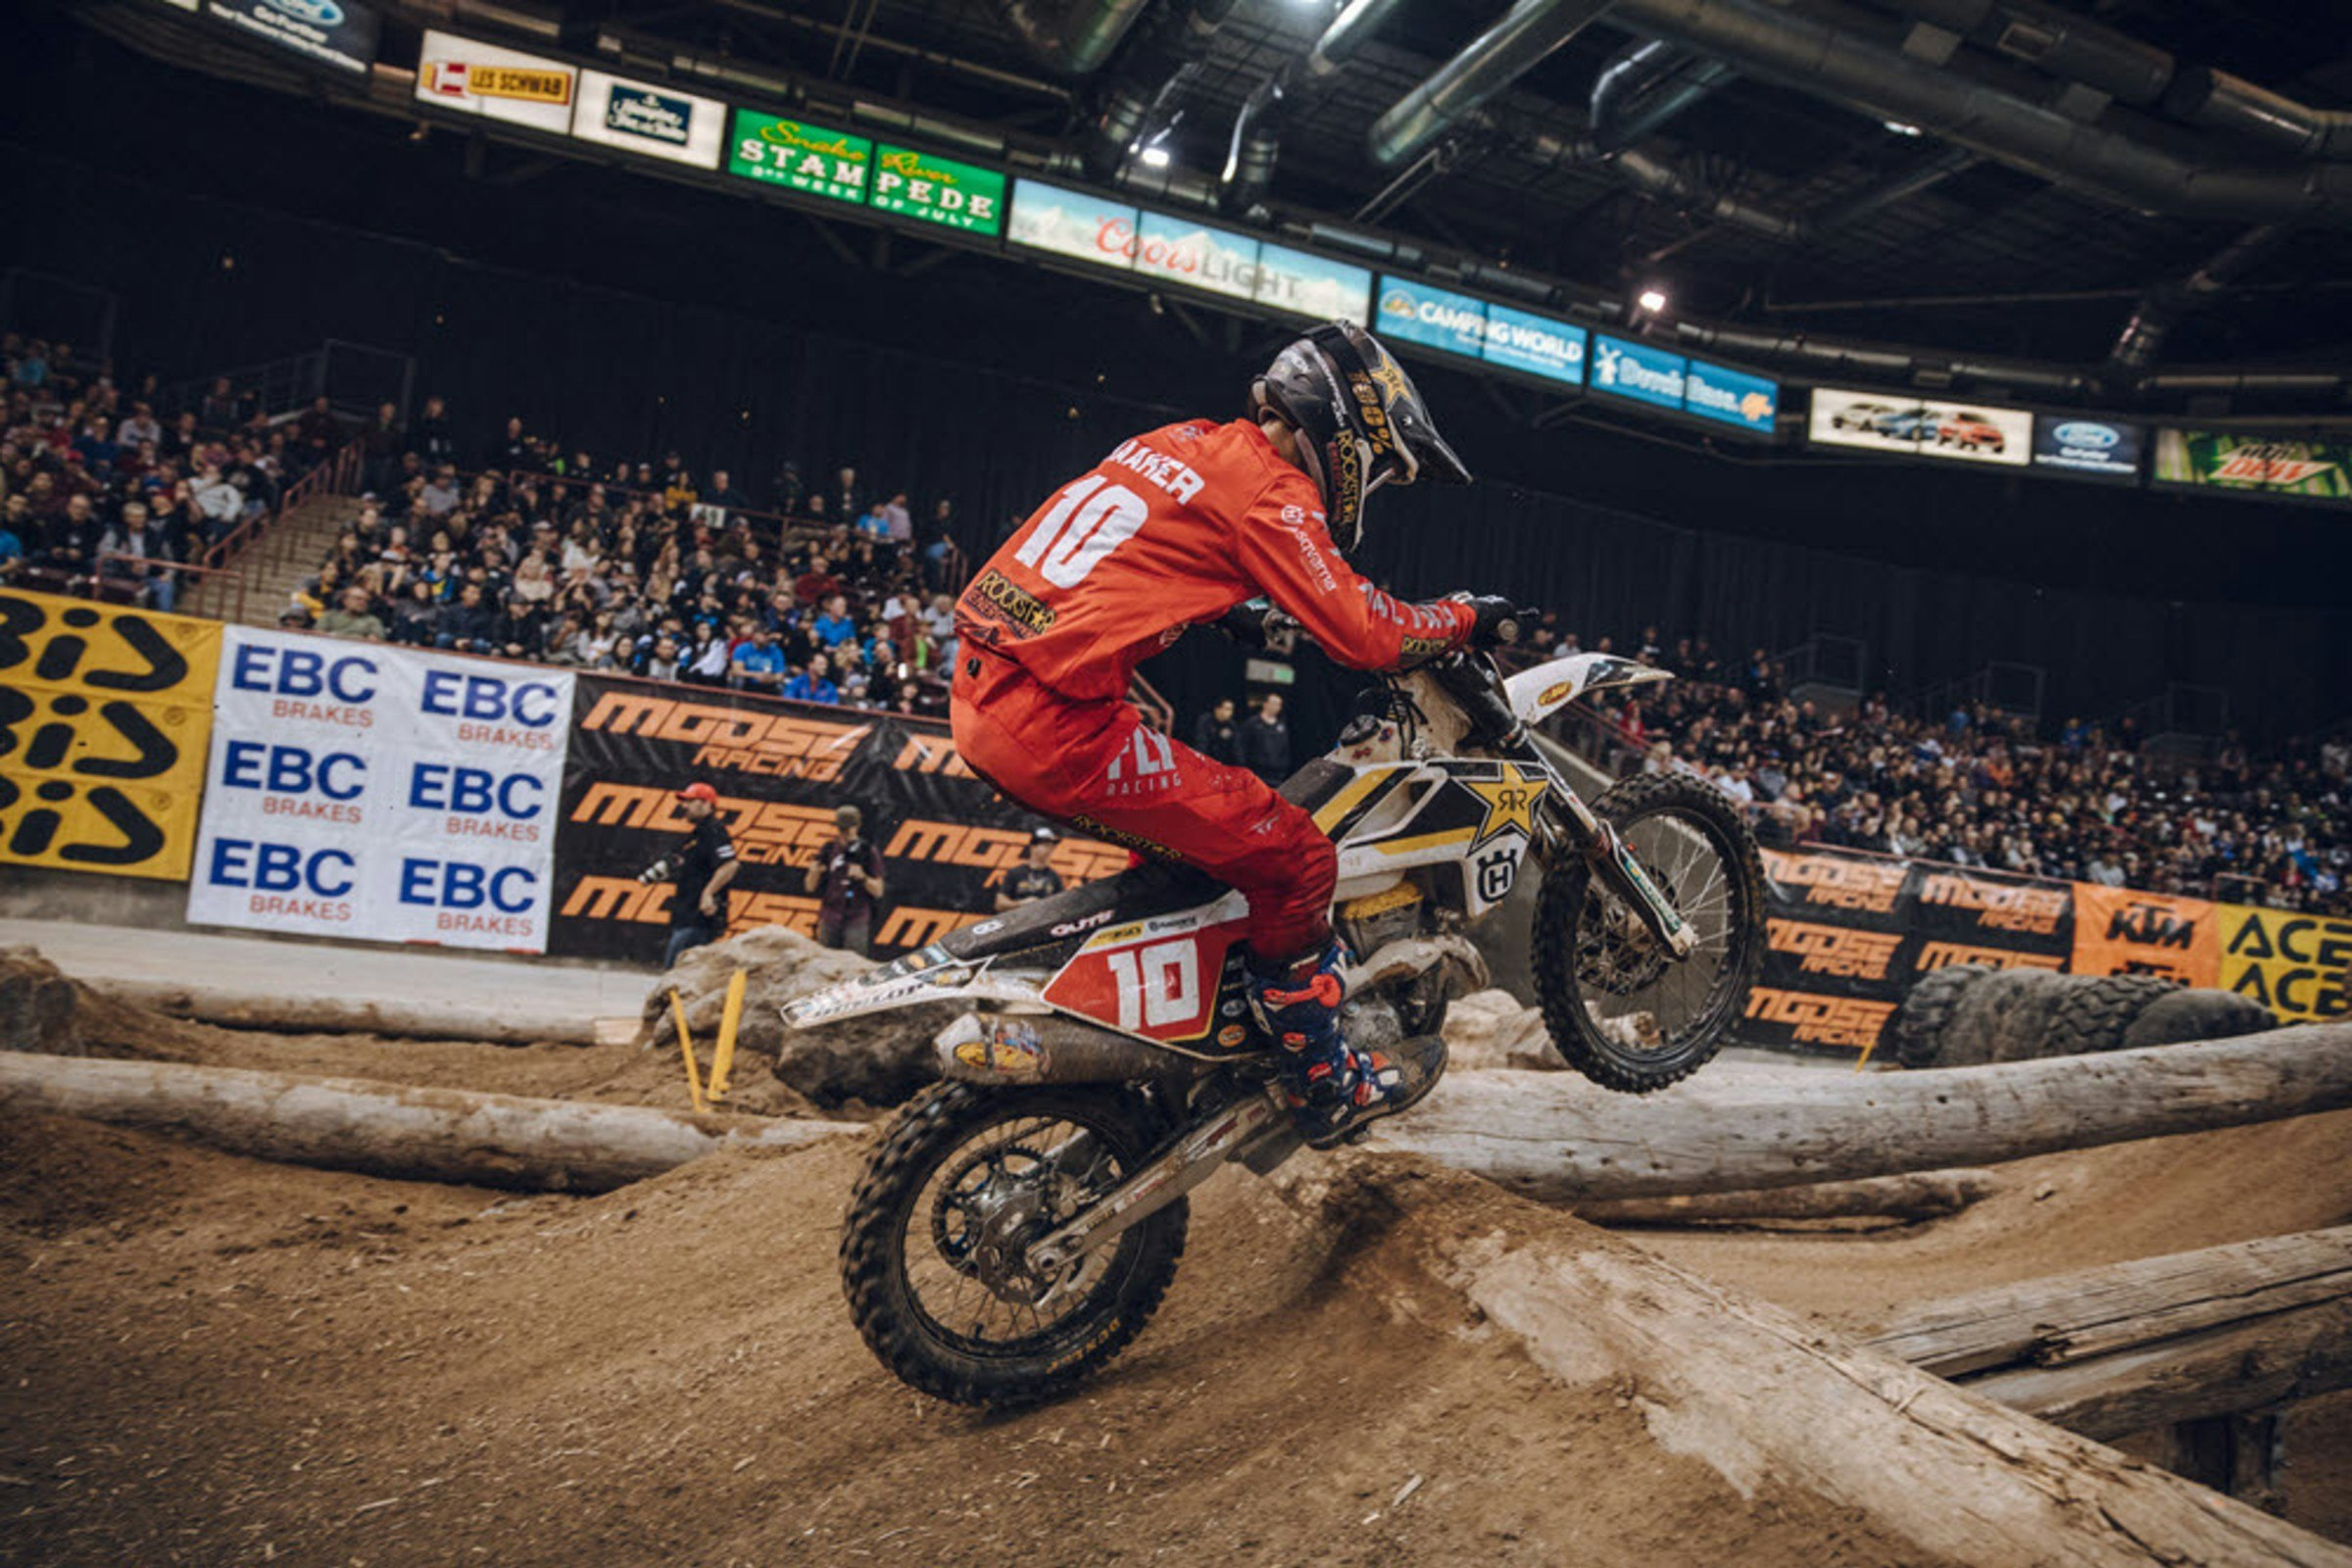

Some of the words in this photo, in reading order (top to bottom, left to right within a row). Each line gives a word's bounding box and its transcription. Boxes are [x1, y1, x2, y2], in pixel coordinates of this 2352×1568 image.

[471, 69, 494, 88] LES
[500, 71, 563, 96] SCHWAB
[740, 138, 994, 220] STAMPEDE
[916, 206, 975, 228] JULY
[1095, 216, 1197, 272] Coors
[1200, 254, 1303, 299] LIGHT
[1419, 300, 1509, 344] CAMPING
[1510, 324, 1583, 364] WORLD
[1013, 474, 1150, 589] 10
[232, 645, 378, 704] EBC
[420, 669, 558, 727] EBC
[272, 699, 373, 728] BRAKES
[458, 723, 554, 752] BRAKES
[581, 691, 872, 760] MOOSE
[222, 740, 367, 801] EBC
[691, 745, 845, 783] RACING
[1106, 773, 1182, 797] RACING
[263, 796, 363, 825] BRAKES
[409, 762, 543, 819] EBC
[446, 815, 540, 843] BRAKES
[209, 838, 356, 898] EBC
[399, 858, 537, 913] EBC
[249, 894, 352, 922] BRAKES
[437, 912, 534, 937] BRAKES
[2106, 901, 2195, 951] KTM
[1107, 937, 1200, 1032] 10
[1799, 954, 1888, 979] RACING
[1791, 1023, 1881, 1048] RACING
